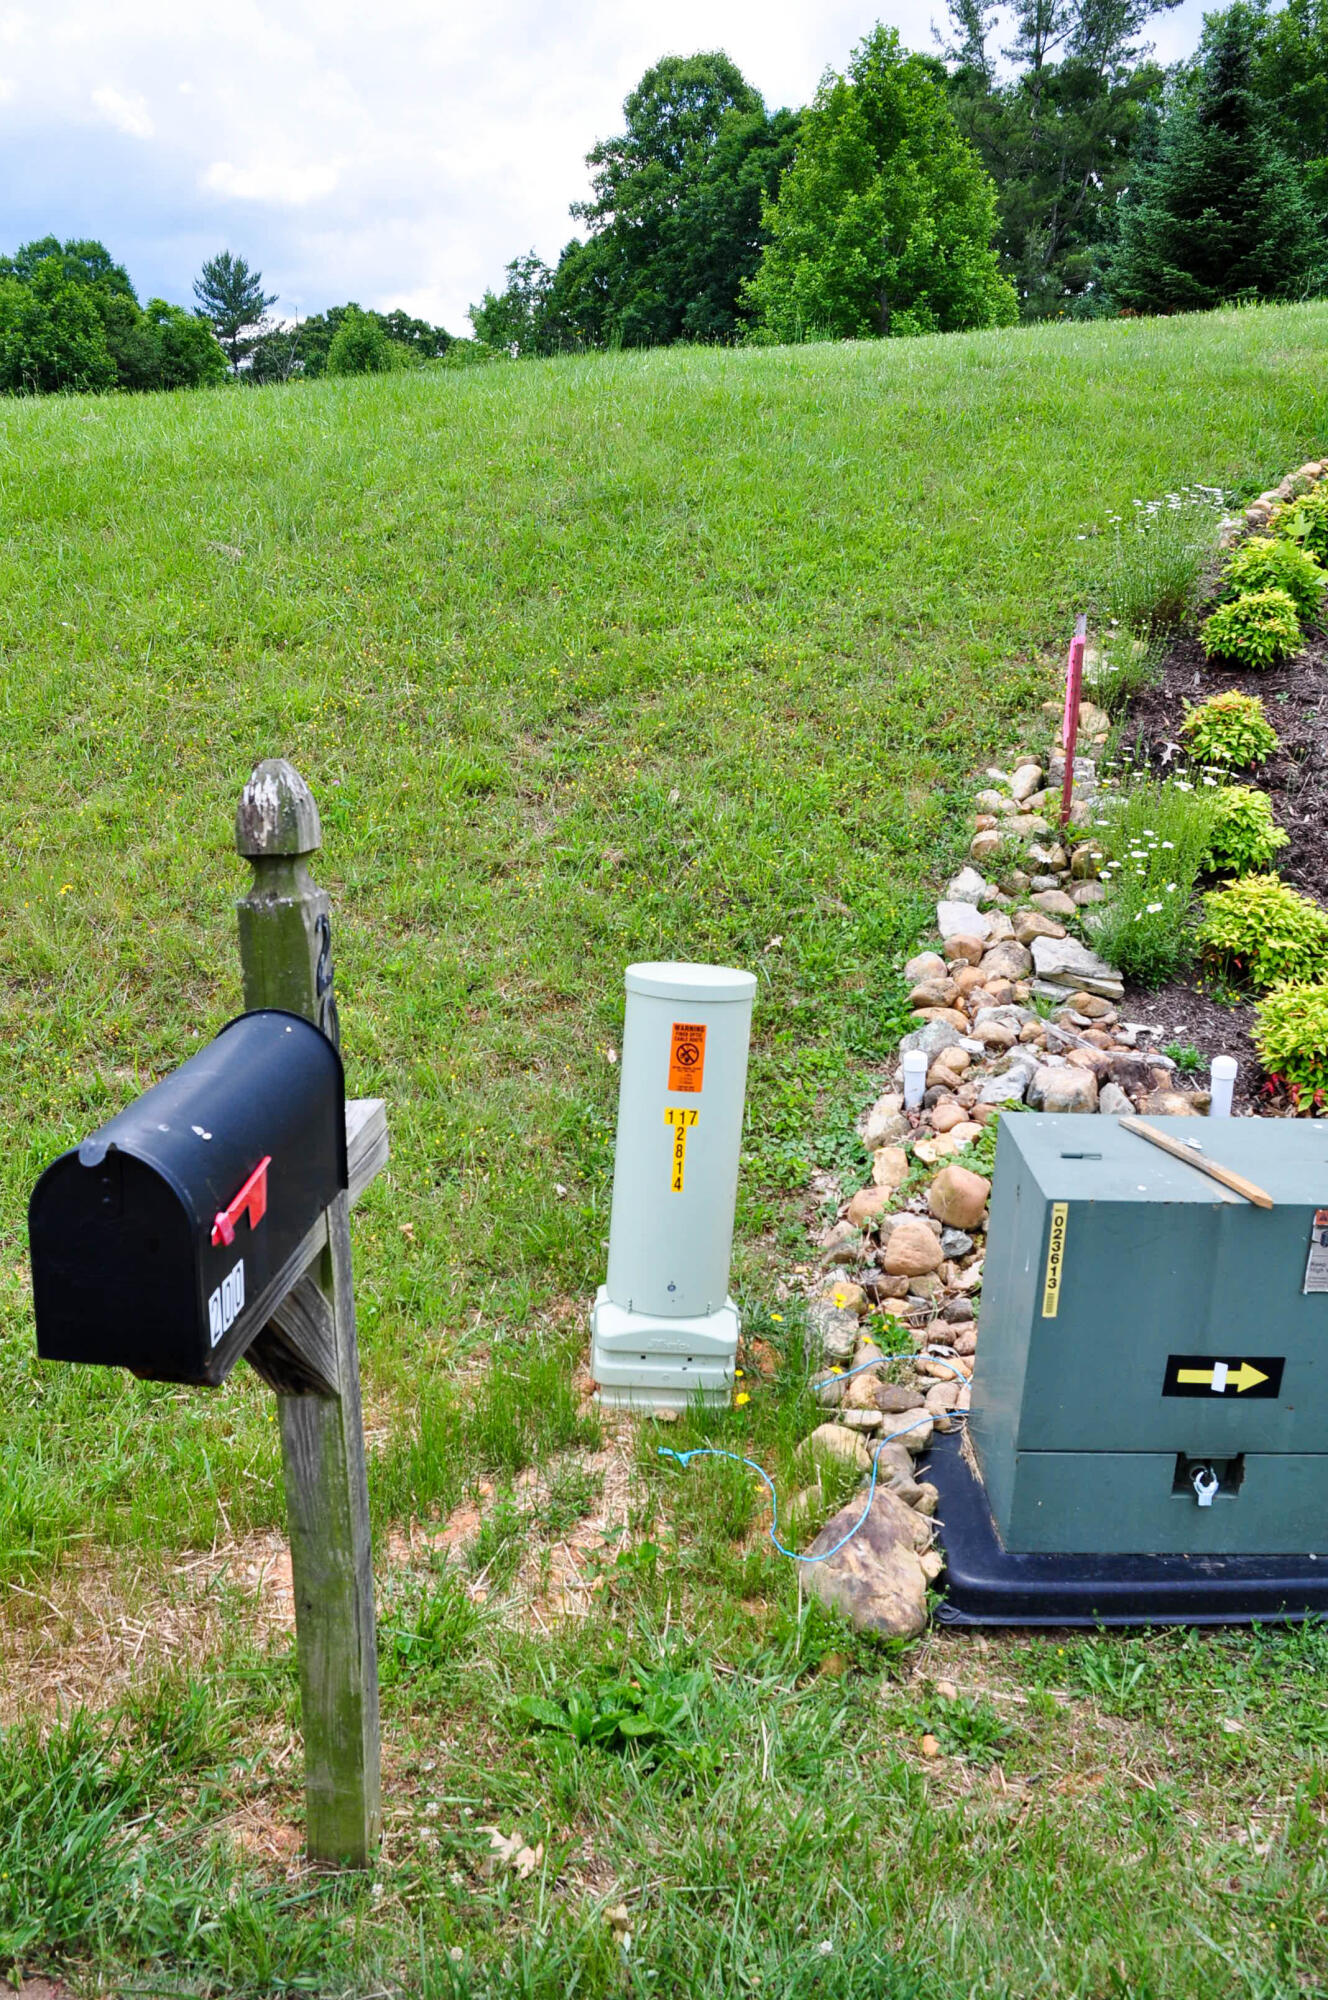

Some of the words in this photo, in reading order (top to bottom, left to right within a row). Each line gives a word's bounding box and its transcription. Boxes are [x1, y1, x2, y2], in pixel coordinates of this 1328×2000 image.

[674, 1024, 705, 1032] WARNING
[667, 1110, 698, 1125] 117
[673, 1126, 684, 1191] 2814
[1047, 1215, 1064, 1289] 023613
[211, 1266, 242, 1340] 200
